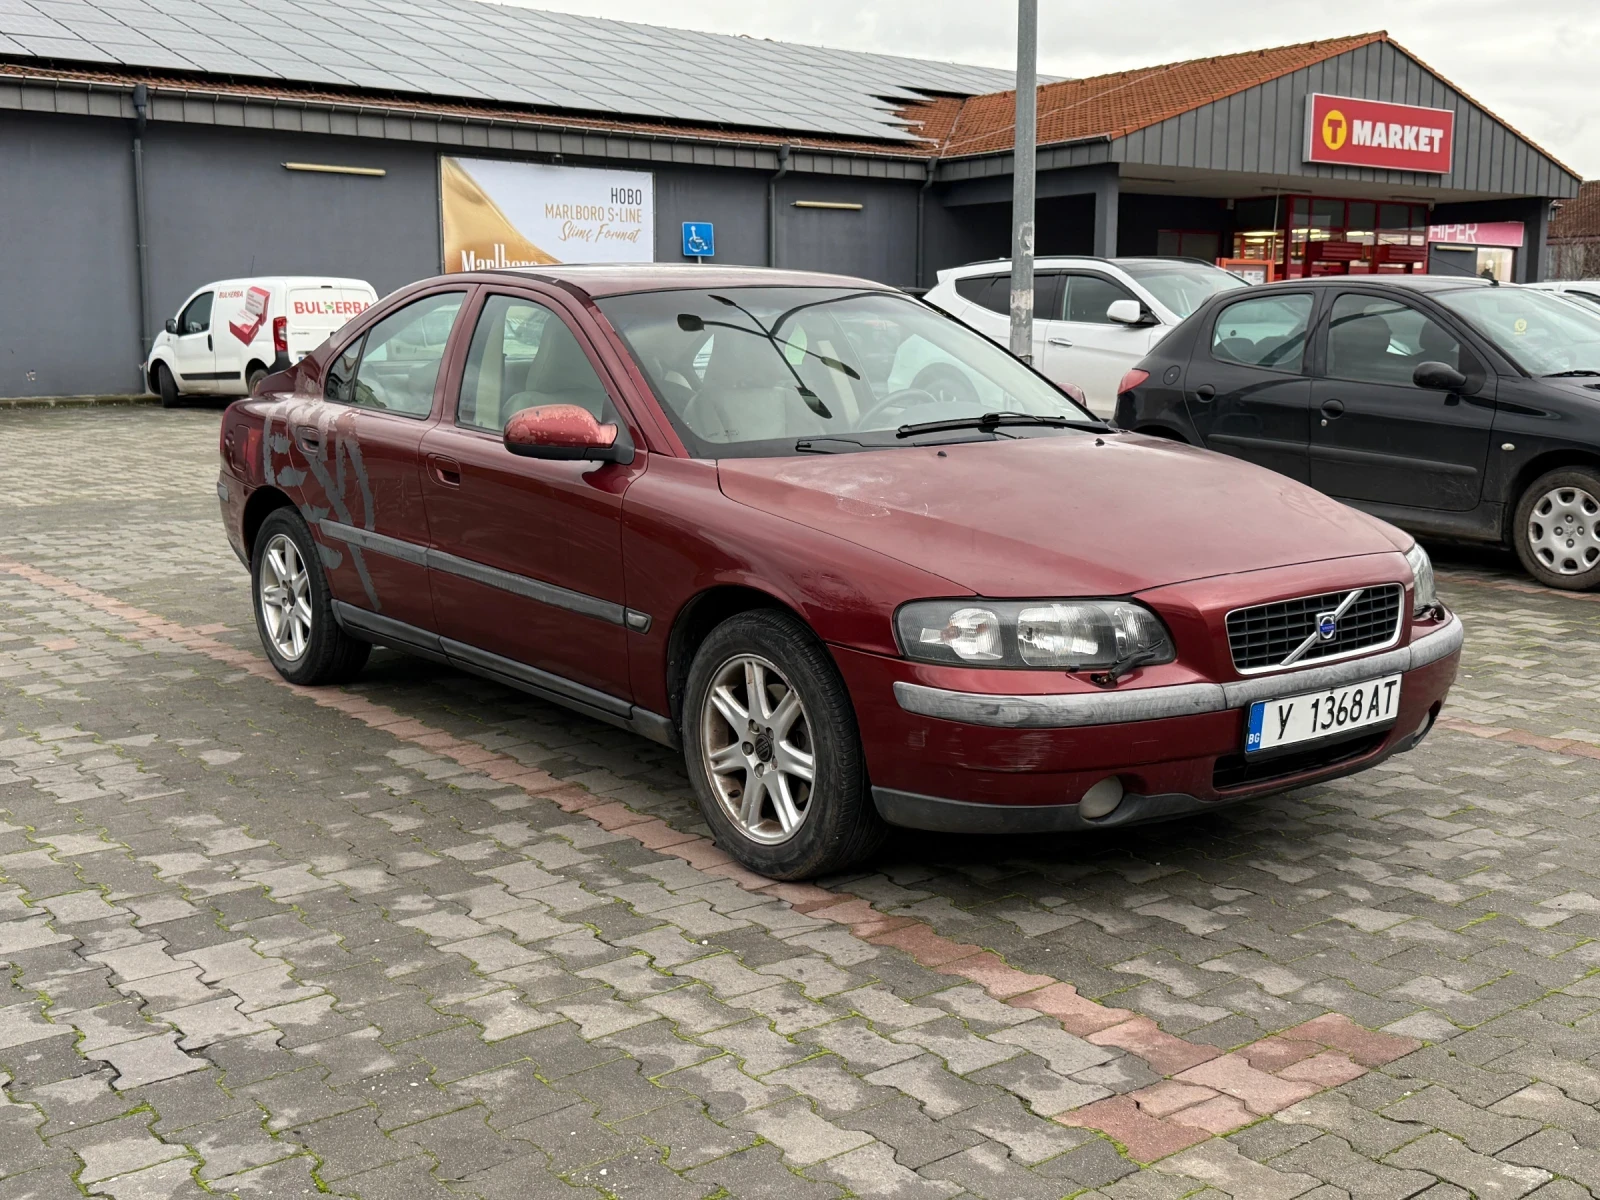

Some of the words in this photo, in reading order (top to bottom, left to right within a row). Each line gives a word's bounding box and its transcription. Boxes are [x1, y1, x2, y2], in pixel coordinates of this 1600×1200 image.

[1351, 119, 1444, 153] MARKET
[610, 187, 642, 206] HOBO
[545, 203, 605, 222] MARLBORO
[595, 223, 641, 243] Format
[1248, 732, 1261, 745] BG
